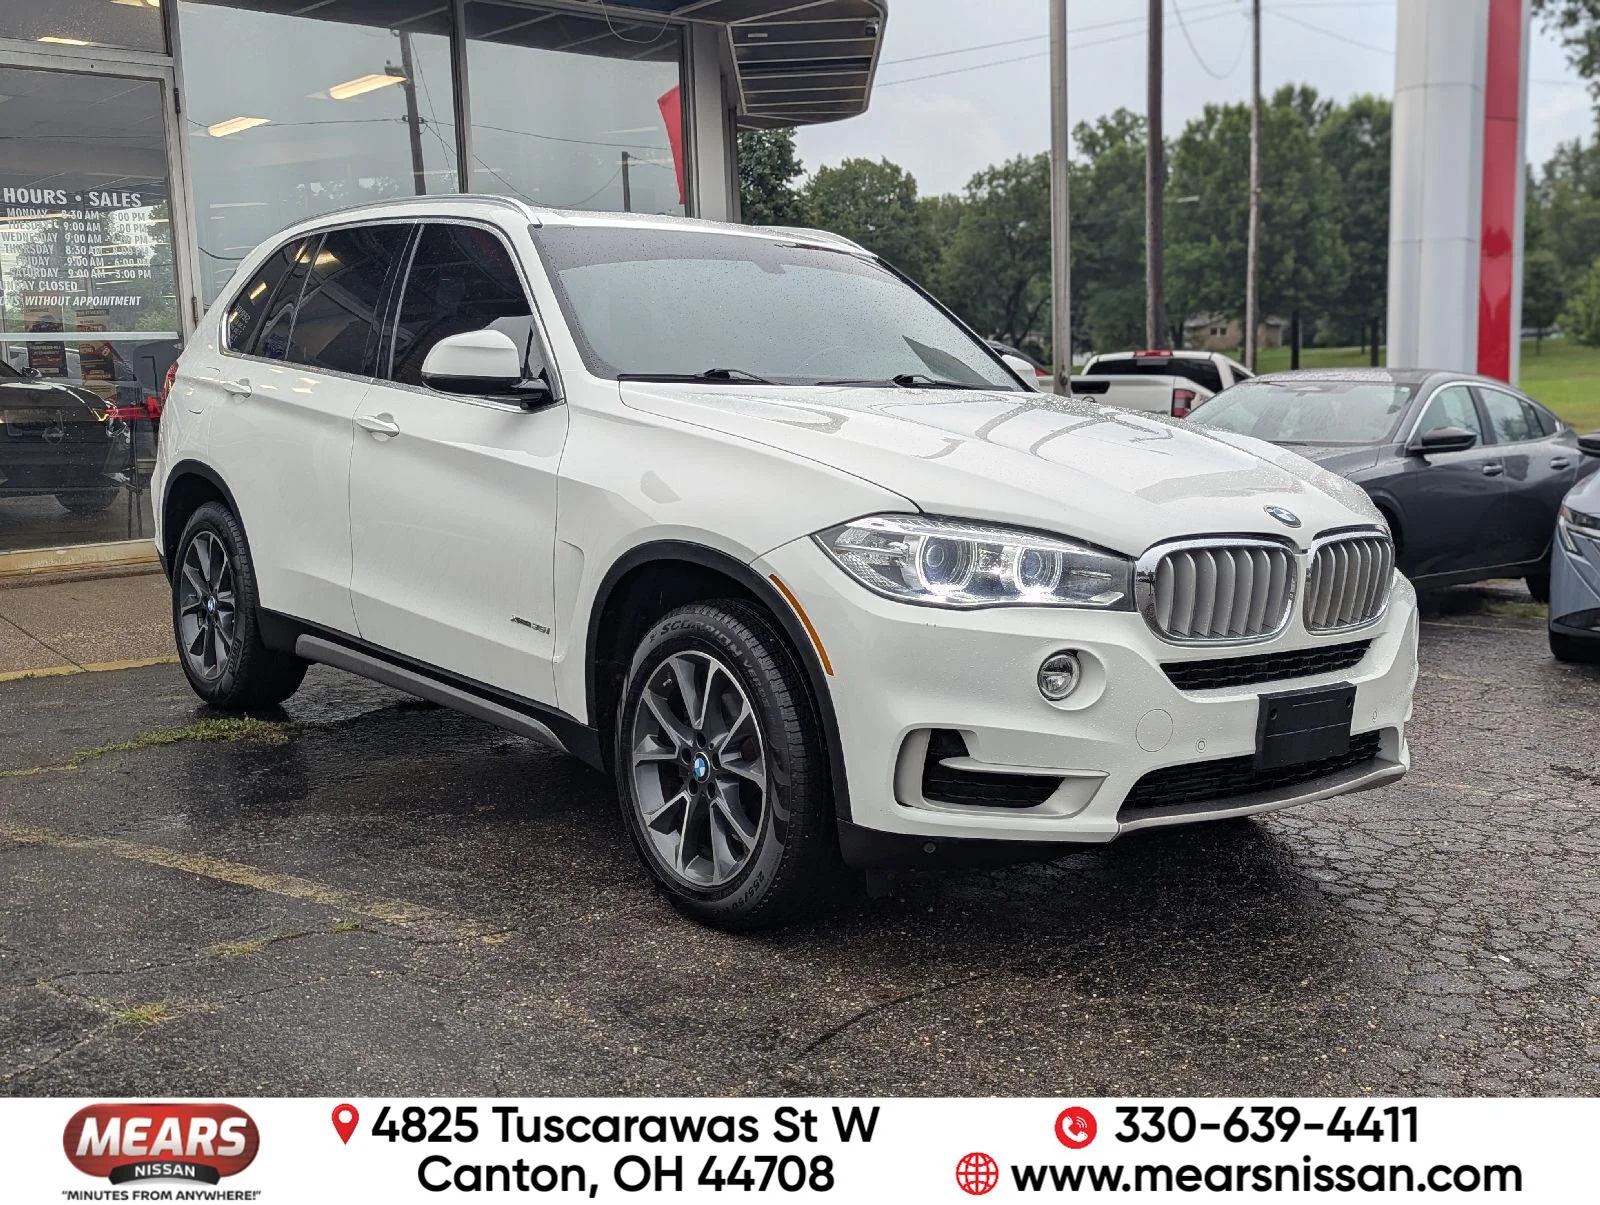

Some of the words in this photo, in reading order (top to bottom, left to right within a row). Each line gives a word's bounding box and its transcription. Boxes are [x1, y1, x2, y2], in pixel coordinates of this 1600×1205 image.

[3, 187, 68, 205] HOURS
[88, 191, 142, 207] SALES
[6, 207, 48, 219] MONDAY
[84, 210, 100, 220] AM
[132, 212, 146, 221] PM
[63, 222, 84, 232] 9:00
[86, 222, 101, 232] AM
[133, 223, 148, 233] PM
[1, 232, 58, 243] WEDNESDAY
[64, 232, 86, 243] 9:00
[87, 233, 102, 243] AM
[134, 235, 148, 244] PM
[4, 243, 54, 255] THURSDAY
[65, 245, 87, 255] 8:30
[88, 245, 103, 255] AM
[66, 256, 88, 267] 9:00
[90, 257, 104, 267] AM
[114, 258, 134, 268] 6:00
[136, 258, 151, 268] PM
[10, 267, 59, 278] SATURDAY
[68, 269, 89, 279] 9:00
[91, 268, 106, 279] AM
[115, 270, 136, 279] 3:00
[137, 270, 152, 279] PM
[39, 281, 78, 291] CLOSED
[25, 296, 71, 306] WITHOUT
[73, 296, 142, 307] APPOINTMENT
